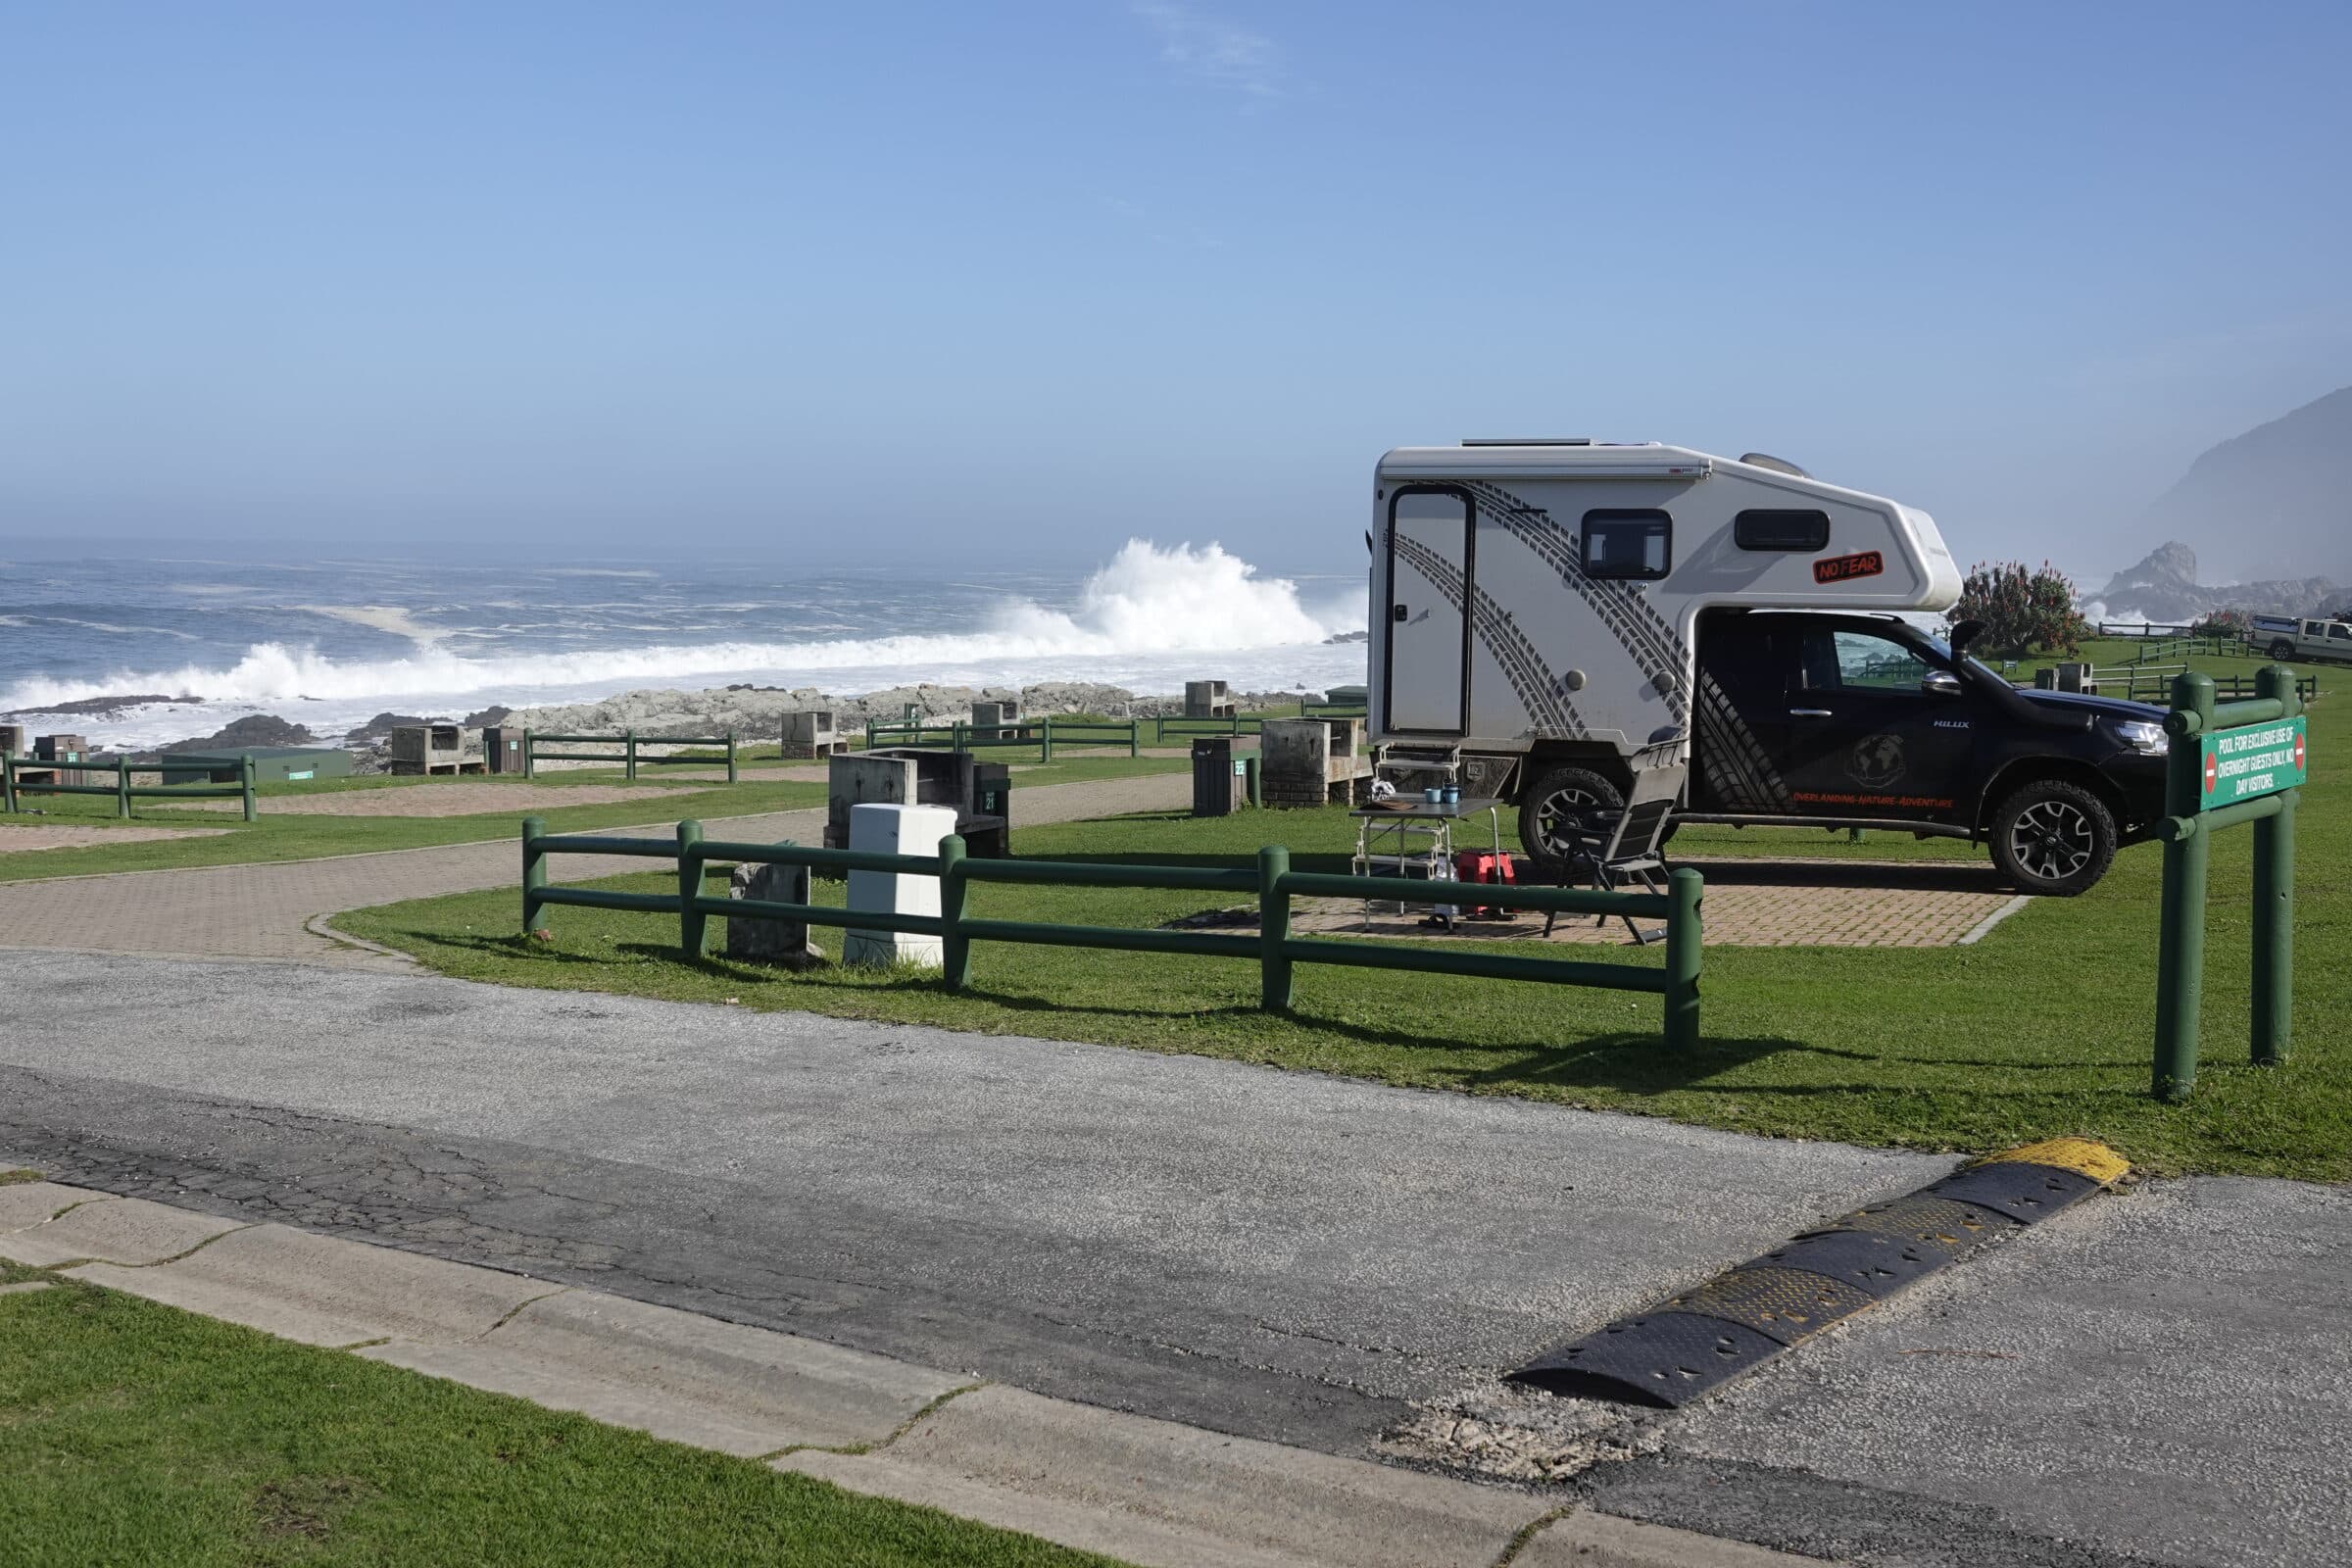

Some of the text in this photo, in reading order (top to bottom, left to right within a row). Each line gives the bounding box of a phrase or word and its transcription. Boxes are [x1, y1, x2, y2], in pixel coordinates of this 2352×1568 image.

[1820, 557, 1877, 578] NO FEAR
[1934, 720, 1970, 729] HILUX
[2219, 726, 2294, 756] POOL FOR EXCLUSIVE USE OF
[2219, 758, 2250, 778] OVERNIGHT
[2250, 753, 2272, 771] GUESTS
[2286, 748, 2294, 763] NO
[2236, 778, 2248, 795] DAY
[985, 798, 994, 809] 21
